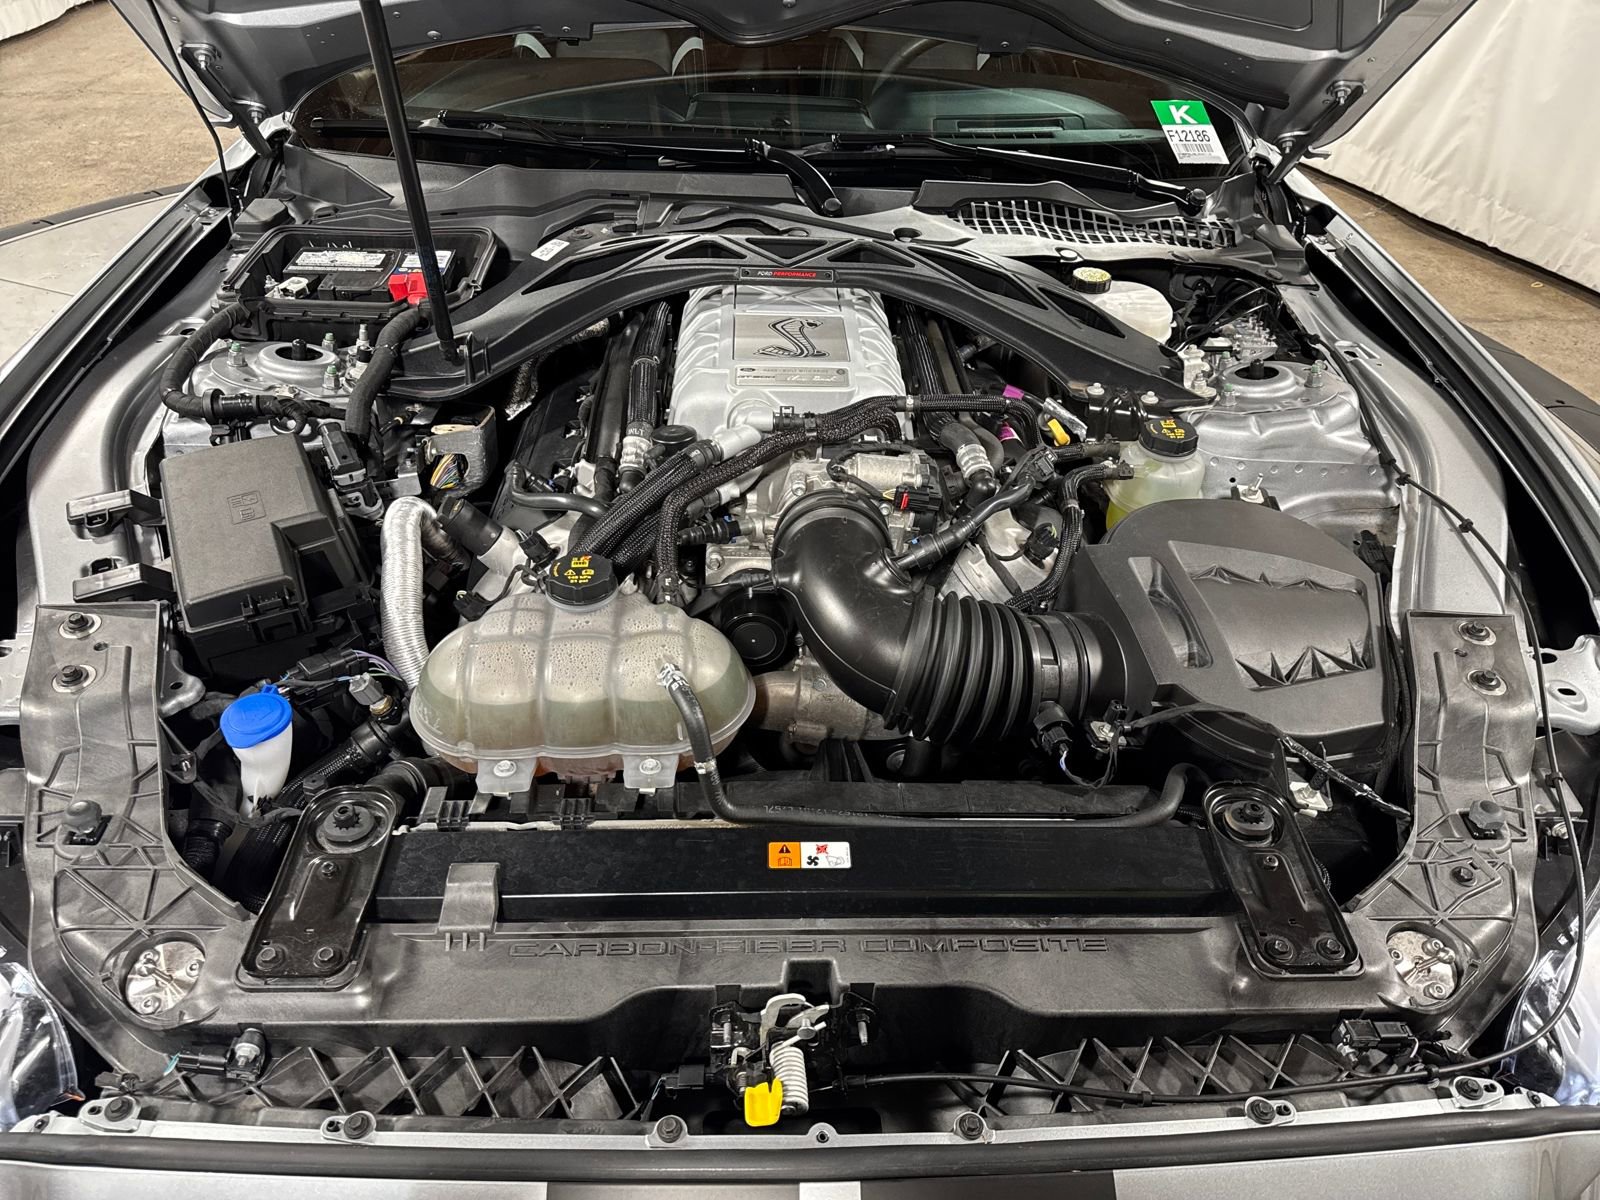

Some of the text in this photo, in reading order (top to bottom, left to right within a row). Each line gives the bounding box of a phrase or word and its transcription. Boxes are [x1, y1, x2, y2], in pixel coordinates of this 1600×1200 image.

[1168, 105, 1198, 124] K
[1167, 129, 1211, 142] F12186
[860, 936, 1109, 953] COMPOSITE
